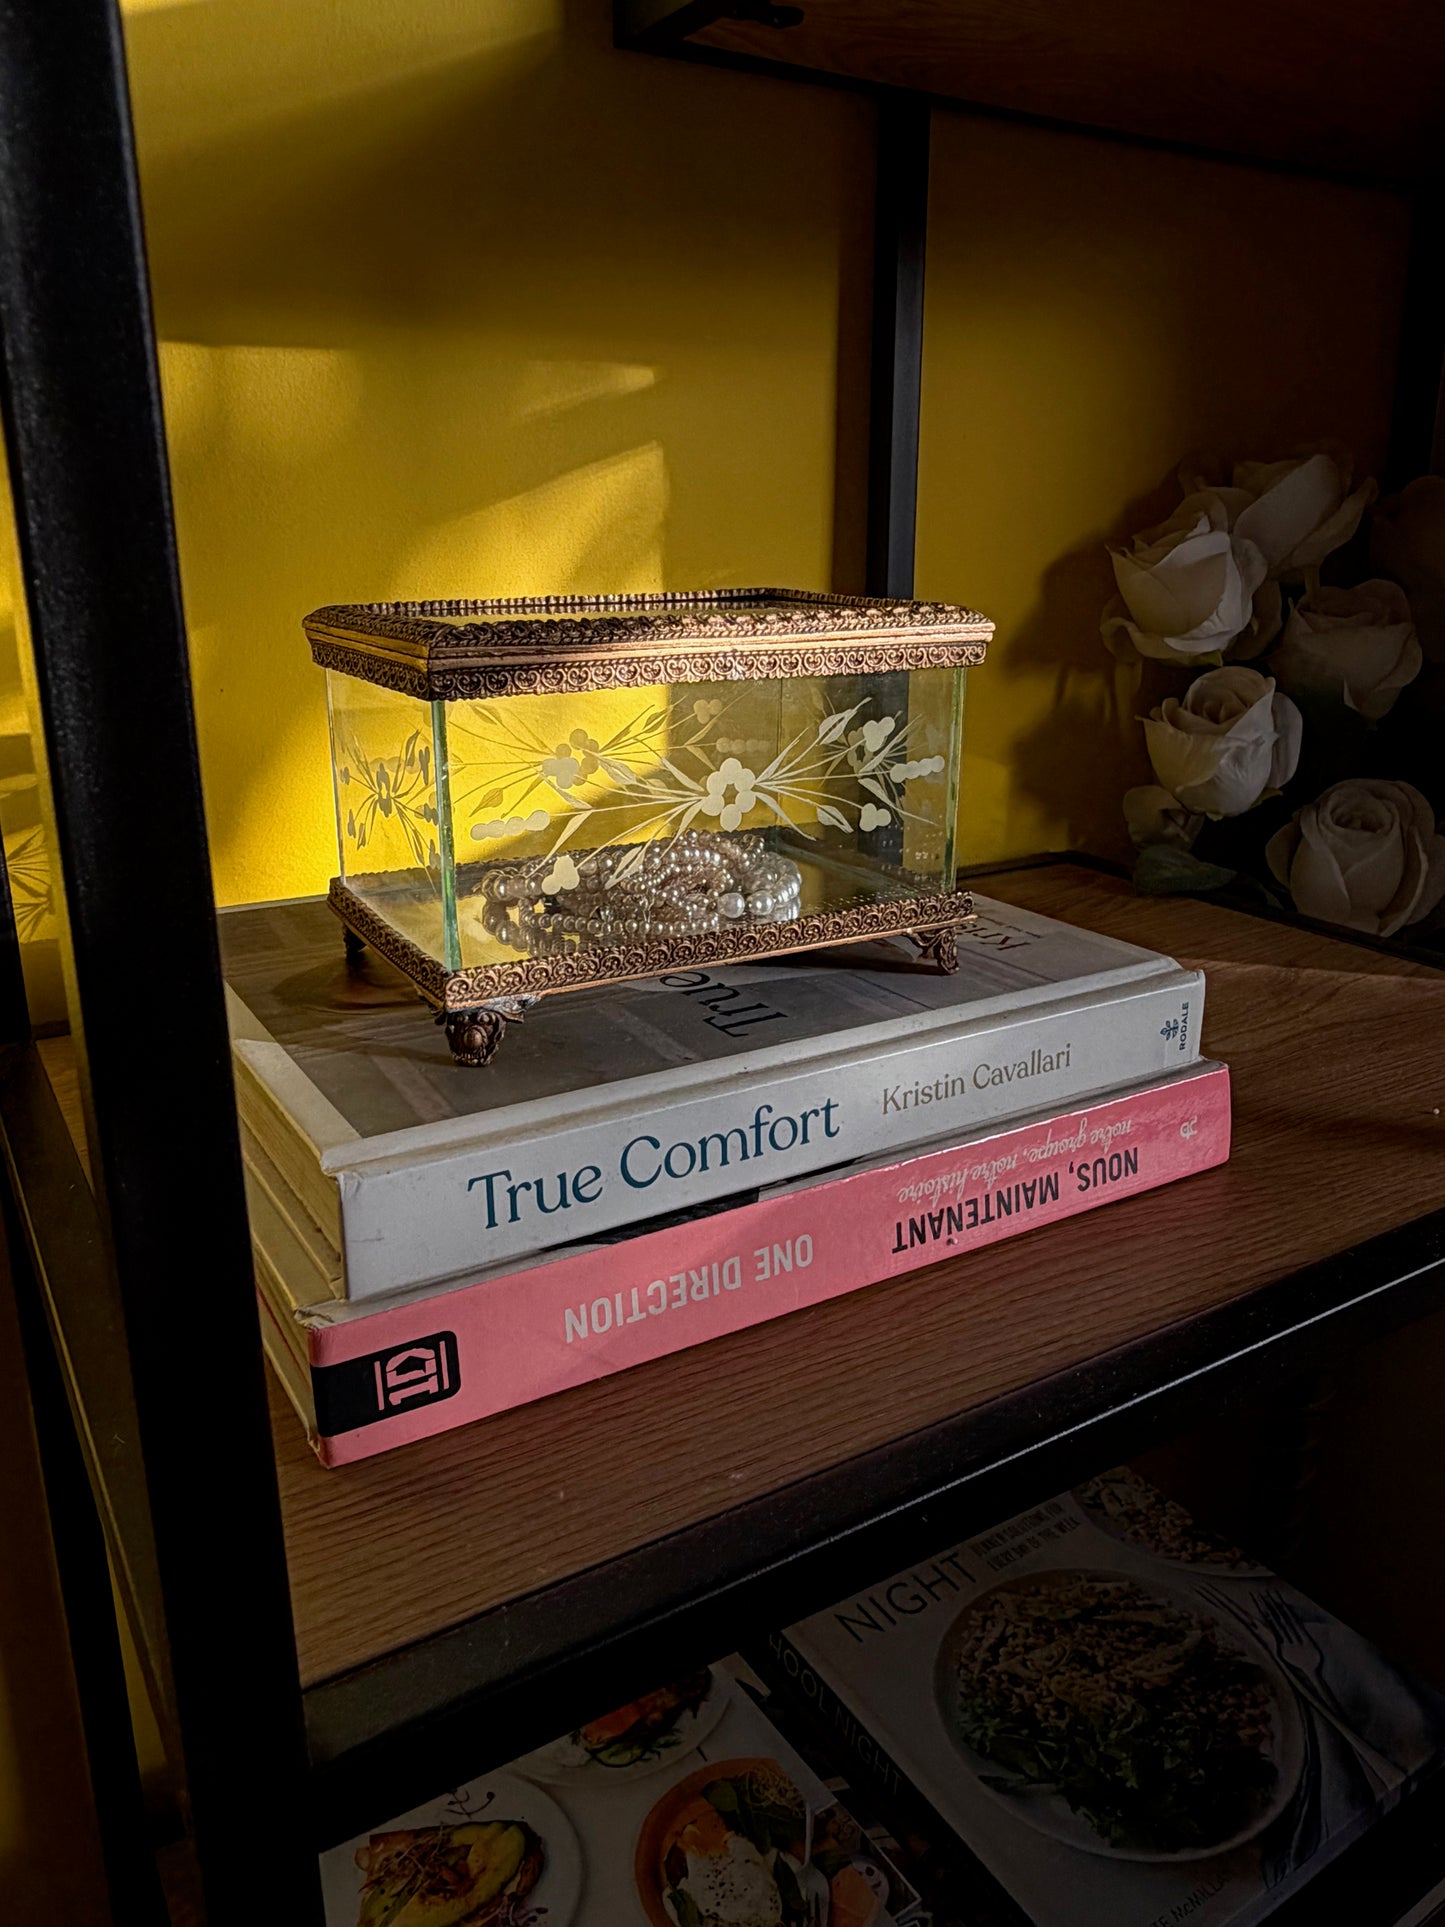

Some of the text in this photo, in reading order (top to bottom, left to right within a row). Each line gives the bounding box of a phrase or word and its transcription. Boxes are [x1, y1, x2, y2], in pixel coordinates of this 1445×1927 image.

[956, 921, 1031, 951] Kris
[660, 971, 788, 1037] True
[1179, 1001, 1190, 1051] RODALE
[881, 1042, 1072, 1116] Kristin Cavallari
[468, 1097, 840, 1230] True Comfort
[1089, 1118, 1133, 1149] notre
[891, 1145, 1139, 1254] NOUS, MAINTENANT
[896, 1167, 969, 1208] histoire
[969, 1152, 1019, 1190] notre
[564, 1231, 815, 1344] ONE DIRECTION
[834, 1552, 977, 1644] NIGHT
[769, 1633, 903, 1796] HOOL NIGHT
